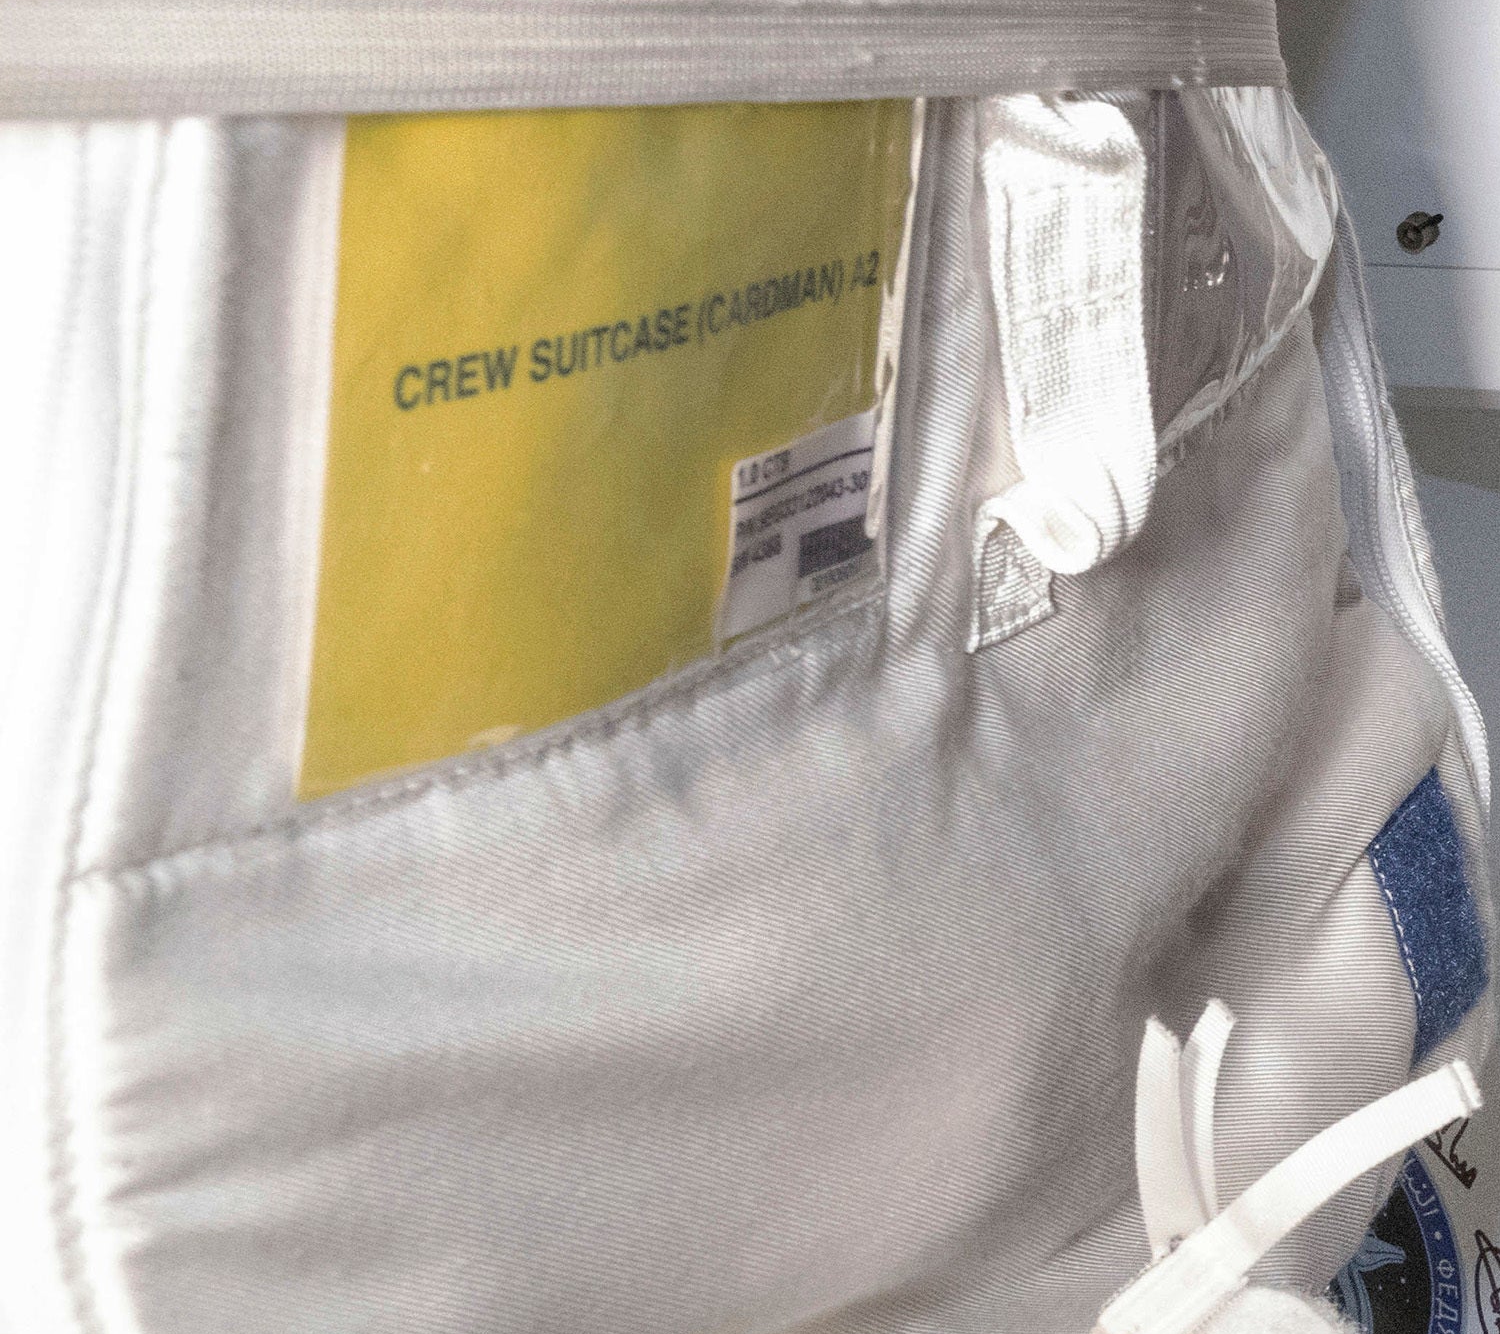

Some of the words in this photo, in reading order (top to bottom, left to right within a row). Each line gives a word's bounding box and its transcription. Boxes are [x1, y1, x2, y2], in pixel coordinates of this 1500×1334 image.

[393, 345, 518, 411] CREW
[529, 304, 690, 384] SUITCASE
[697, 262, 846, 342] (CARDMAN)
[848, 249, 882, 289] A2
